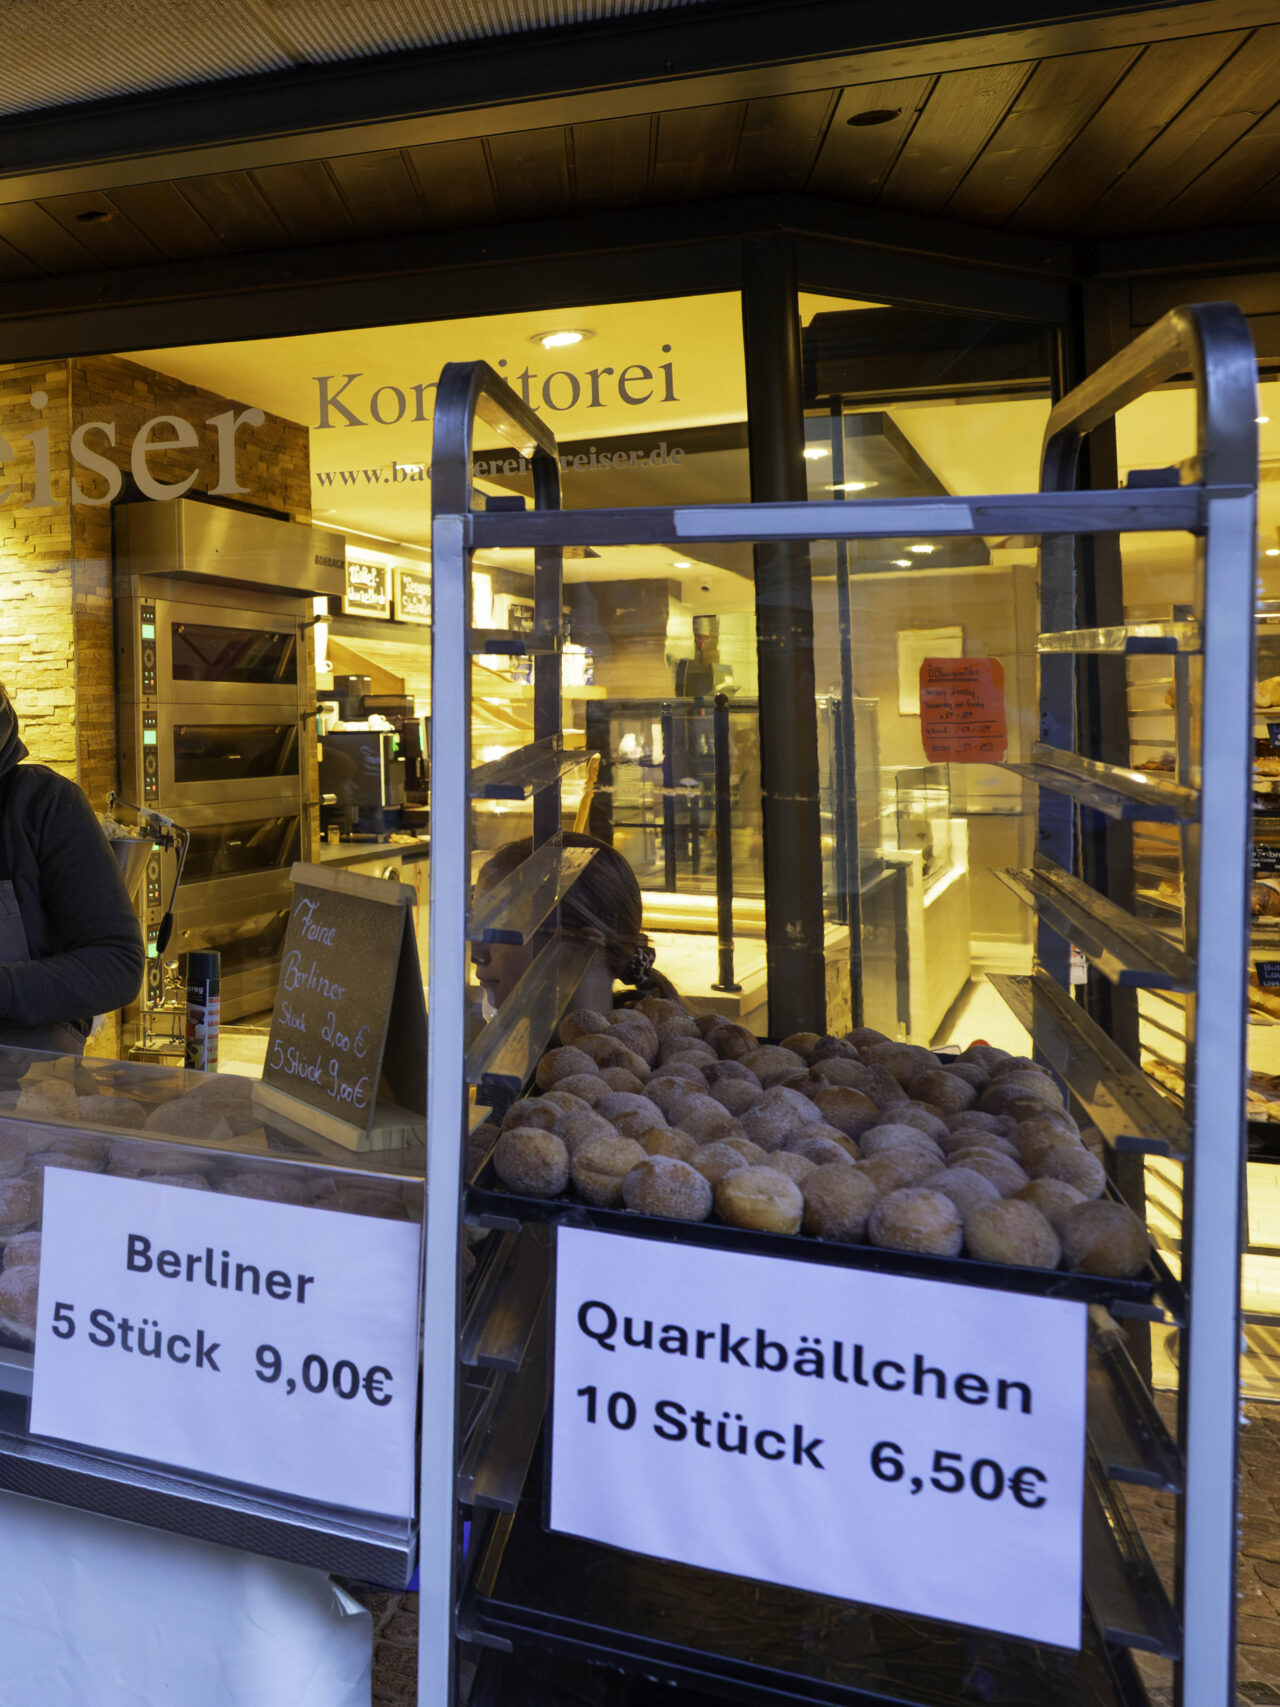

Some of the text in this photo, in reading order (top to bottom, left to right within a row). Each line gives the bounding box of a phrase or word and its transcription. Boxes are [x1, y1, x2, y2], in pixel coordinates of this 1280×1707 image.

[312, 344, 680, 430] Konitorei
[282, 950, 345, 1000] Berliner
[270, 1039, 283, 1070] 5
[285, 1047, 323, 1086] Stück
[126, 1233, 314, 1304] Berliner
[51, 1301, 394, 1407] 5 Stück 9,00€
[576, 1299, 1033, 1415] Quarkbällchen
[576, 1384, 1048, 1510] 10 Stück 6,50€
